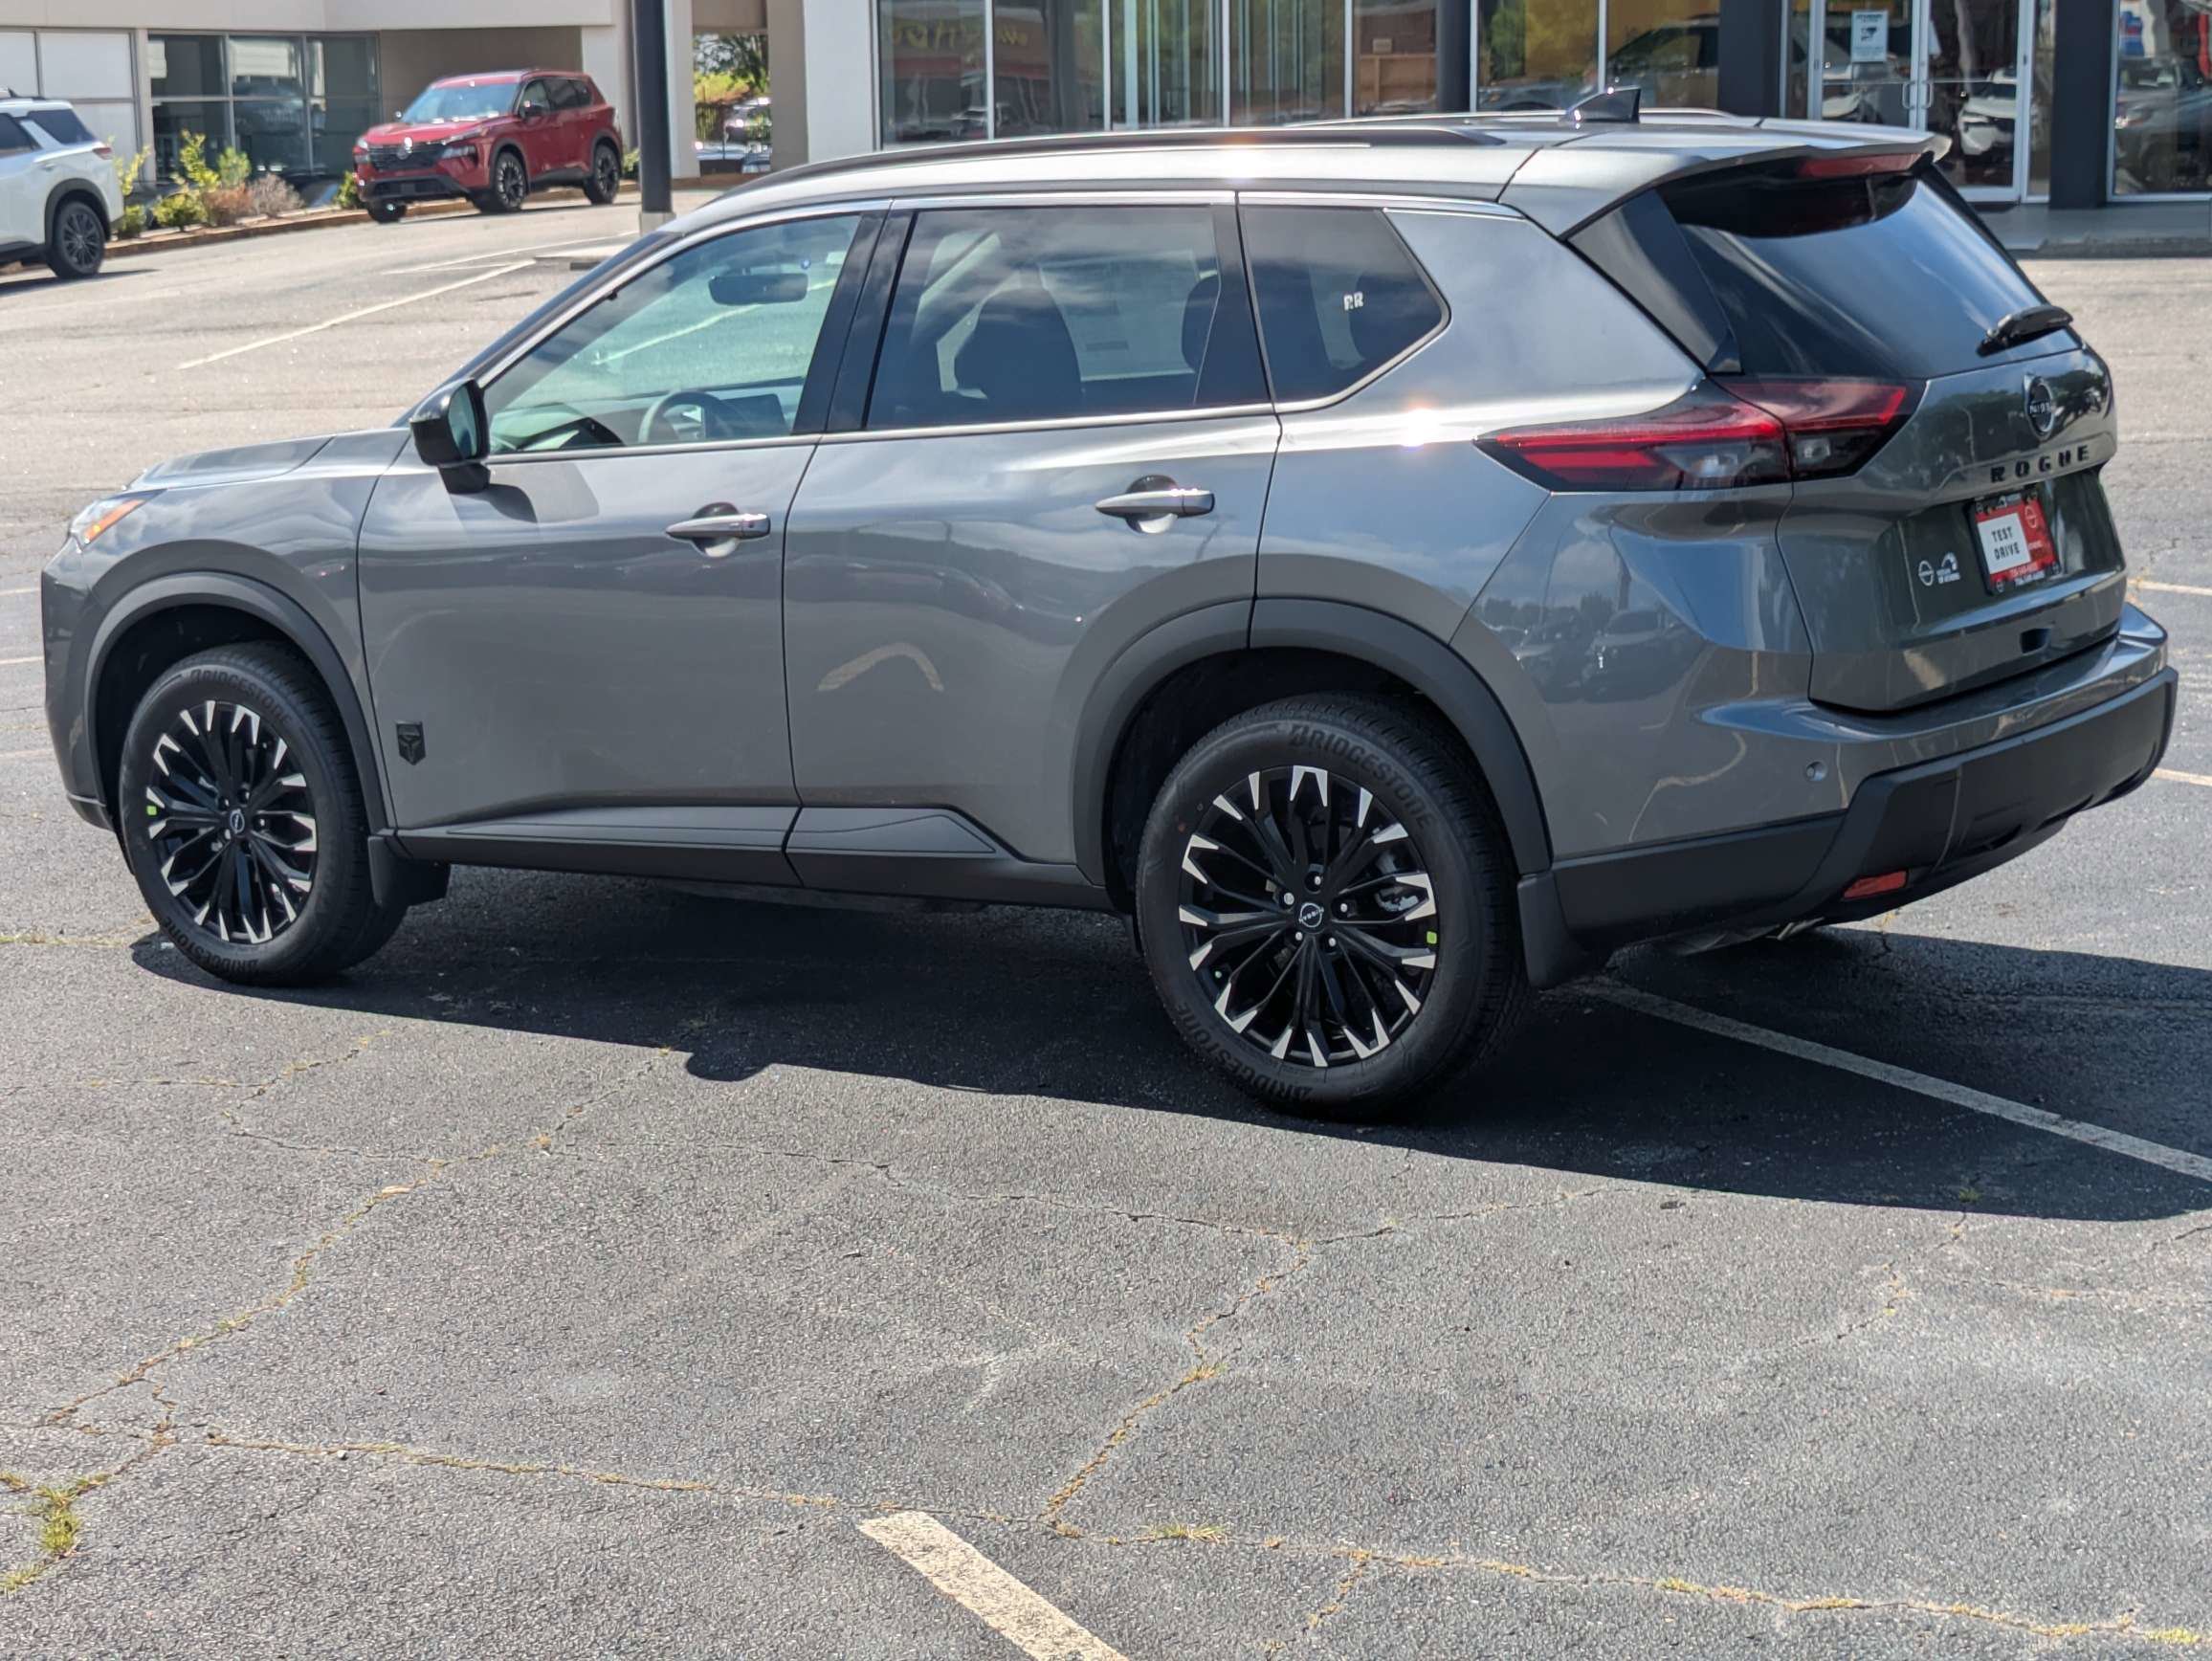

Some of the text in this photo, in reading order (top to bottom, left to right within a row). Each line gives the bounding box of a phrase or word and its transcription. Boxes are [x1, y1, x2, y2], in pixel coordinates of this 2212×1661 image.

[1990, 445, 2090, 483] ROGUE
[1991, 525, 2013, 543] TEST
[1994, 542, 2021, 561] DRIVE
[1288, 723, 1436, 830] BRIDGESTONE
